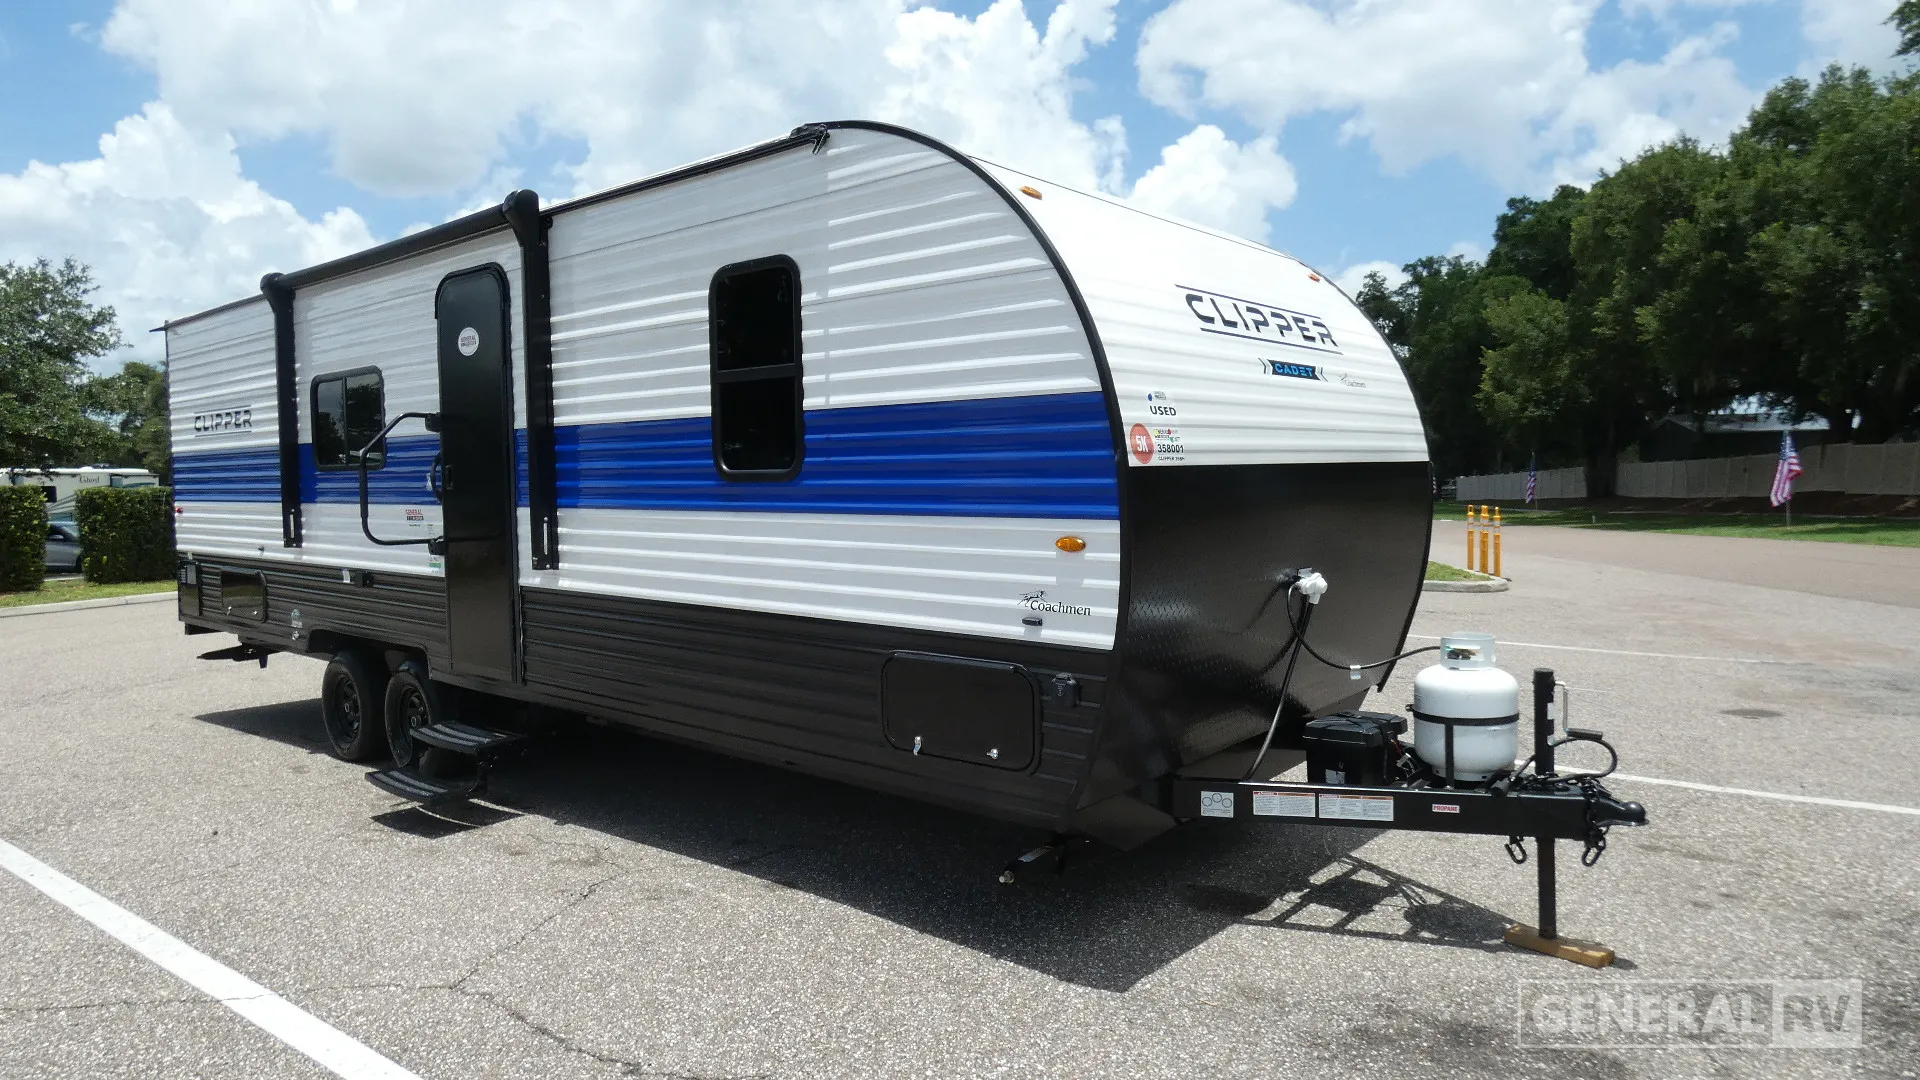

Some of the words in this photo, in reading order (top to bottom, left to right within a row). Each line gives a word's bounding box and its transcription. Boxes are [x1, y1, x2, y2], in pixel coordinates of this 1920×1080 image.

[1185, 293, 1338, 347] CLIPPER
[1274, 363, 1314, 377] CADET
[1149, 405, 1177, 416] USED
[194, 410, 252, 432] CLIPPER
[1157, 443, 1184, 453] 358001
[1030, 600, 1092, 616] Coachmen
